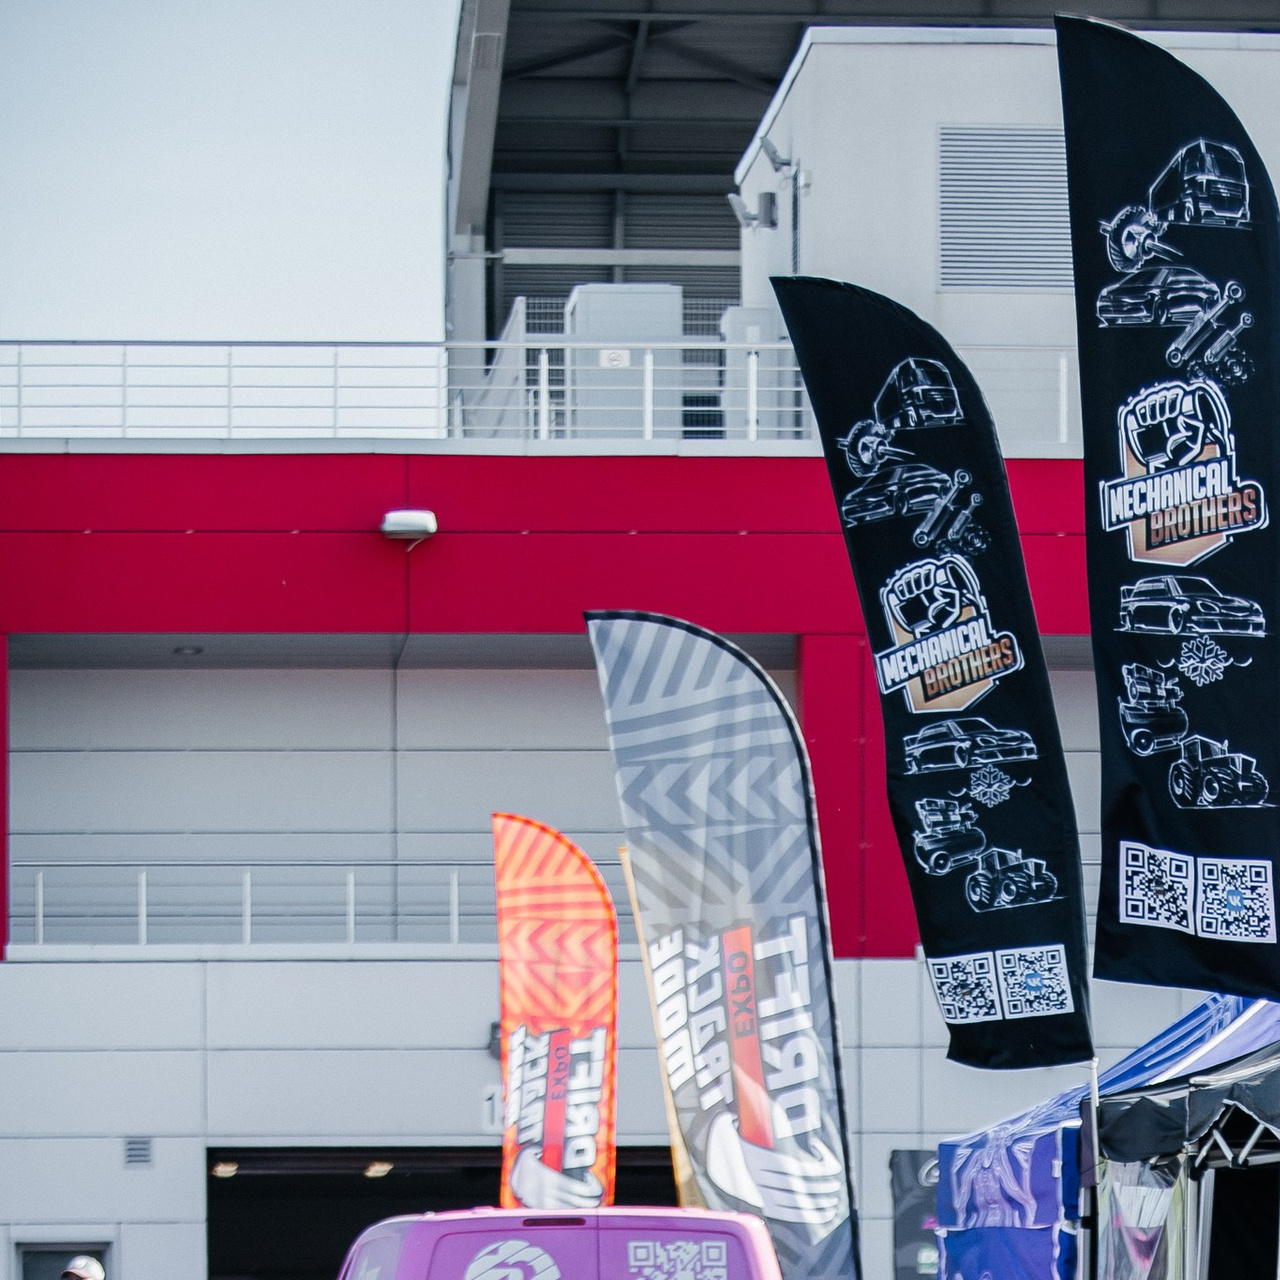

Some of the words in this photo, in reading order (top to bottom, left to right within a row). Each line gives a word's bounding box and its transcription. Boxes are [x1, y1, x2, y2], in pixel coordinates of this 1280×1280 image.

[1109, 458, 1234, 524] MECHANICAL
[1149, 487, 1257, 550] BROTHERS
[880, 617, 991, 689] MECHANICAL
[923, 638, 1014, 698] BROTHERS
